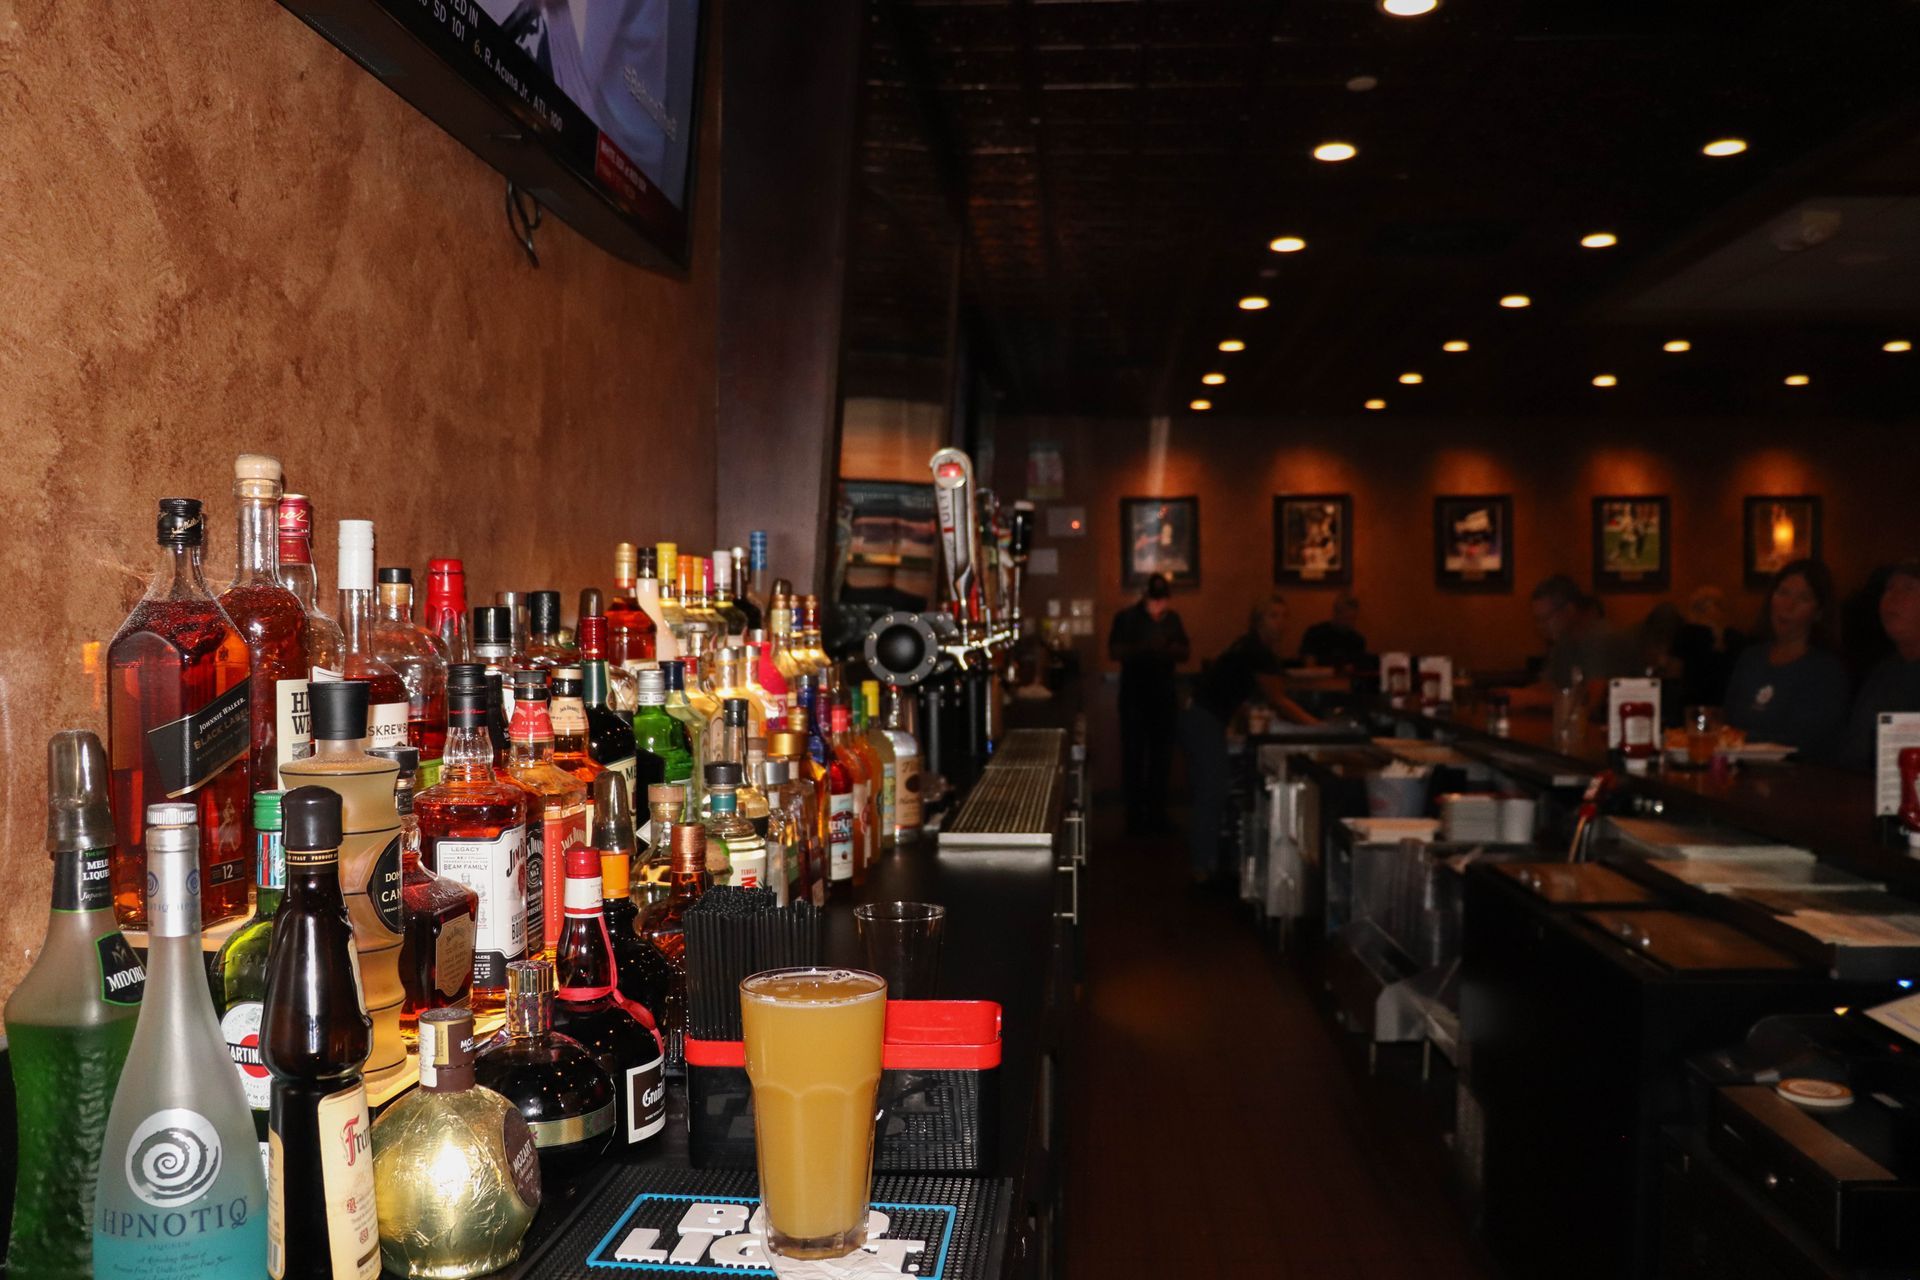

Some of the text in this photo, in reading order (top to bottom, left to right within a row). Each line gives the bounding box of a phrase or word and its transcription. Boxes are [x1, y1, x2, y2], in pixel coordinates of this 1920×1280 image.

[468, 5, 478, 28] IN
[368, 723, 408, 737] SKREWB
[82, 869, 110, 880] LIQUE
[222, 864, 233, 880] 12
[464, 863, 488, 871] FAMILY
[513, 1139, 532, 1173] MOZART
[102, 1198, 248, 1238] HPNOTIQ
